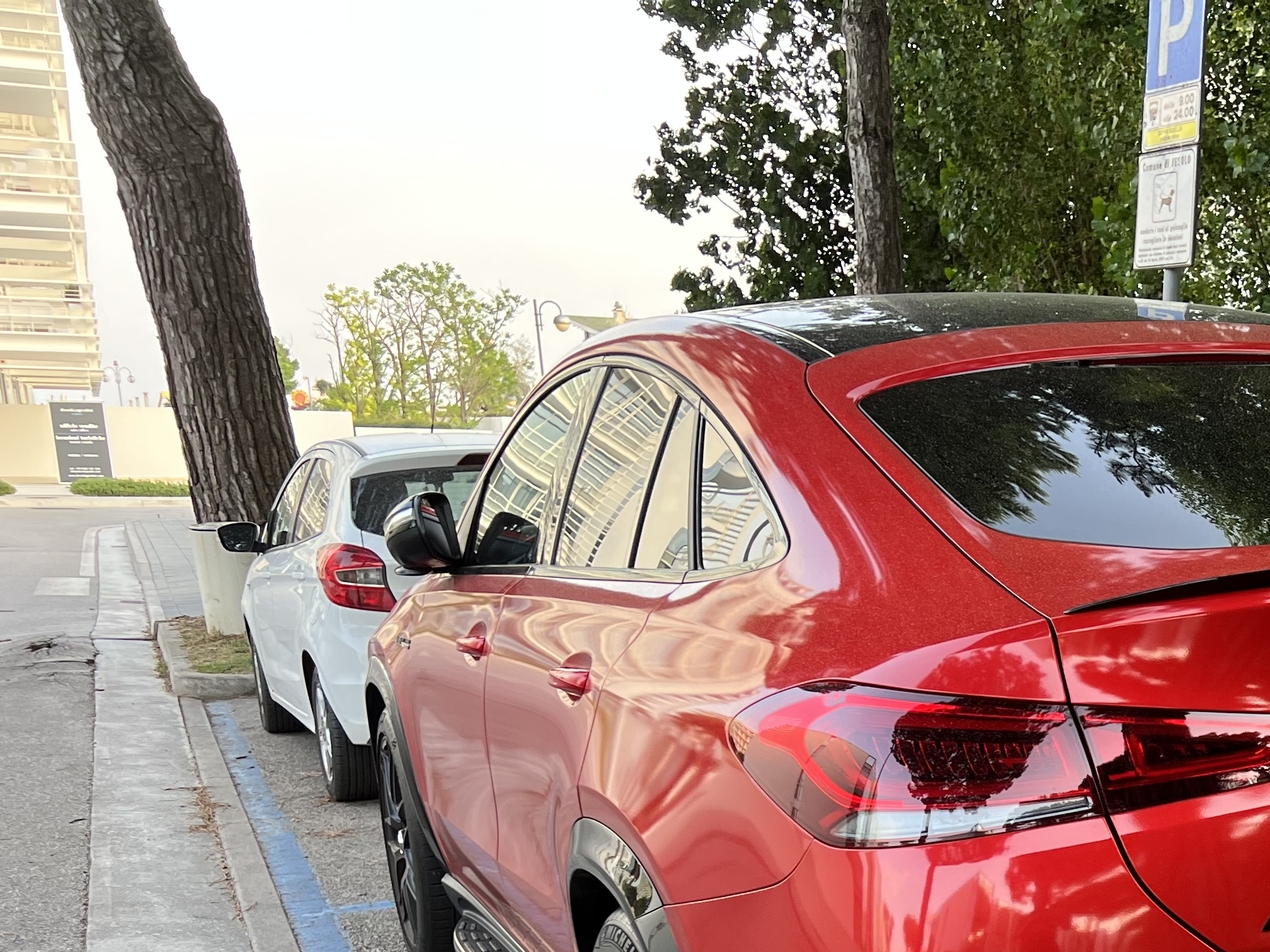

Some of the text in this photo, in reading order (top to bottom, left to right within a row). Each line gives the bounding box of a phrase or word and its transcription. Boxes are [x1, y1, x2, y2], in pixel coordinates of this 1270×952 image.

[1179, 93, 1194, 106] 9.00
[1173, 106, 1194, 120] 24.00
[1142, 155, 1191, 172] Comune di JESOLO
